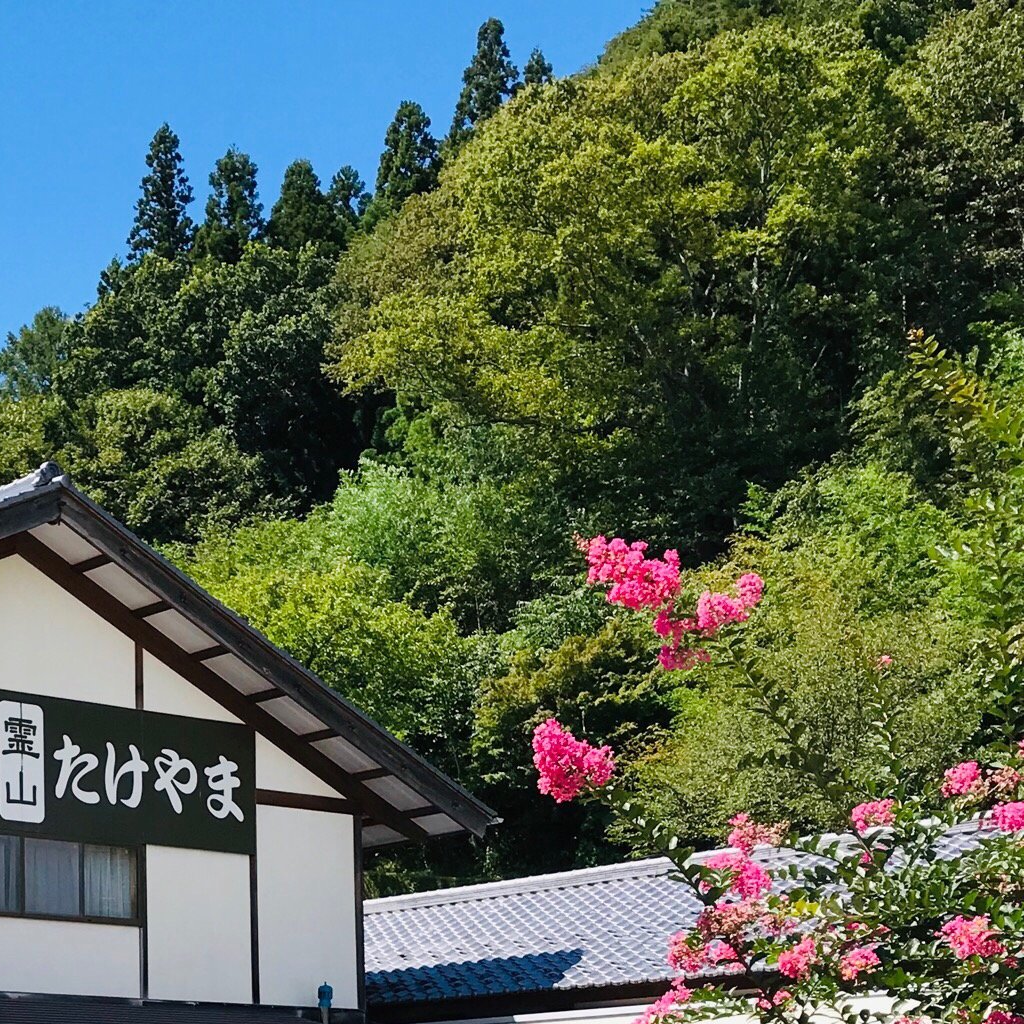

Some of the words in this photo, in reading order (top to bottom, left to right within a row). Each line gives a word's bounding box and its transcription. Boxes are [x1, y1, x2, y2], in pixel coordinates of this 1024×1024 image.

[2, 716, 41, 807] 霊山
[53, 734, 245, 823] たけやま
